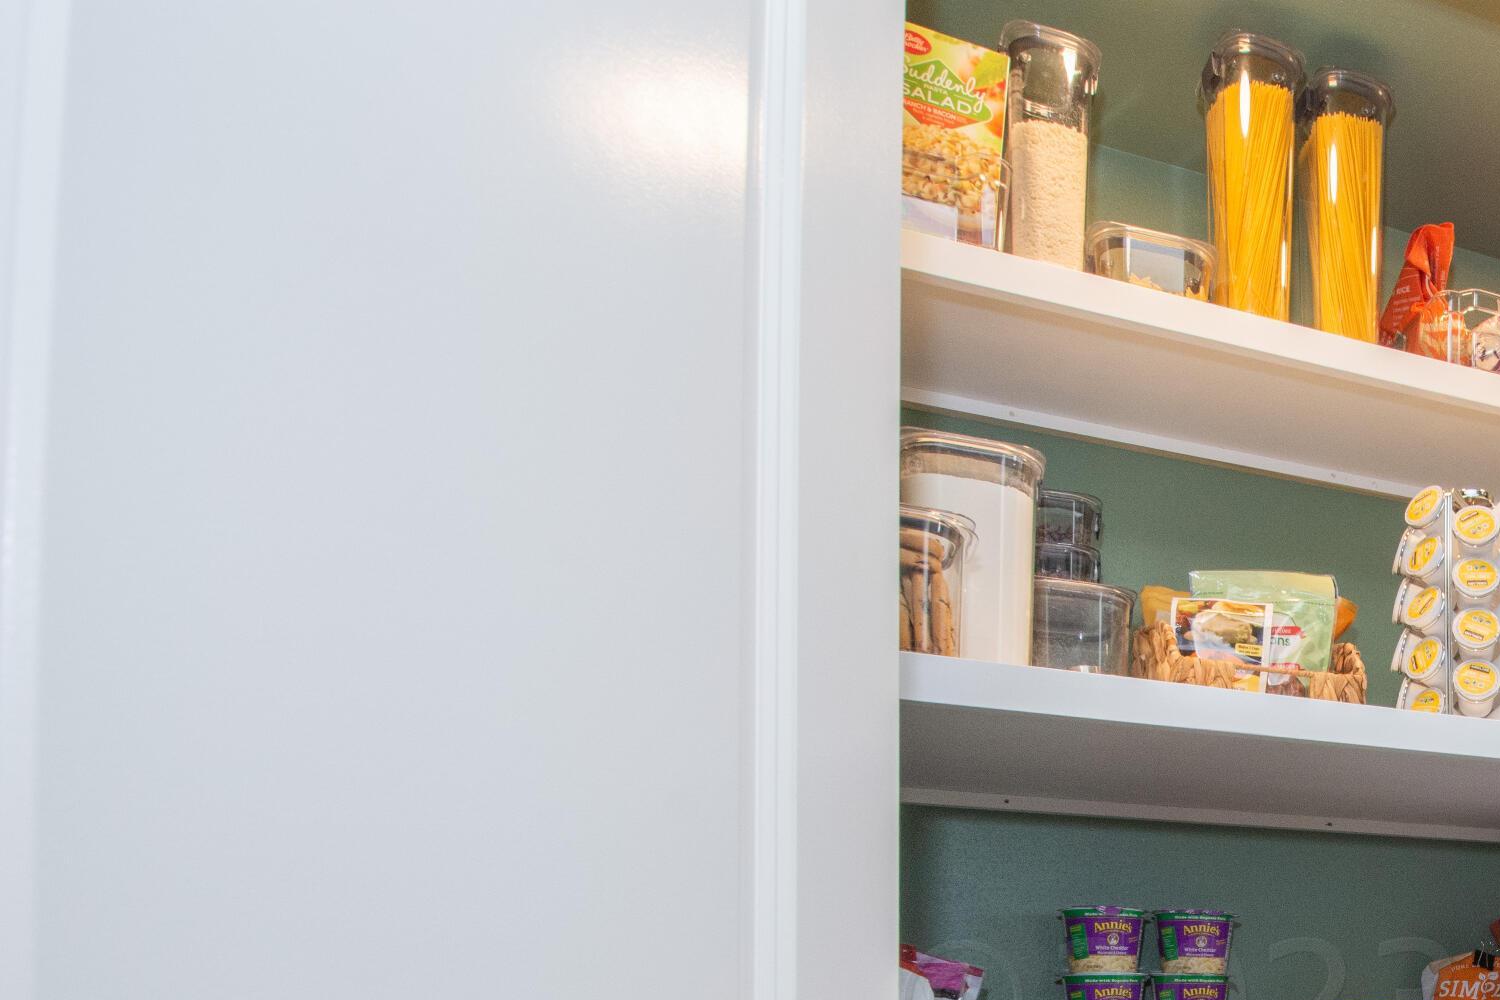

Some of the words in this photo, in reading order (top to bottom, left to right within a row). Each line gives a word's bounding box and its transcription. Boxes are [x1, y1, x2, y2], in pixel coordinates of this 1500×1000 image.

[903, 83, 972, 115] SALAD
[1094, 920, 1133, 934] Annie's
[1183, 923, 1221, 937] Annie's
[1094, 986, 1133, 1000] Annie's
[1183, 986, 1219, 999] Annie's
